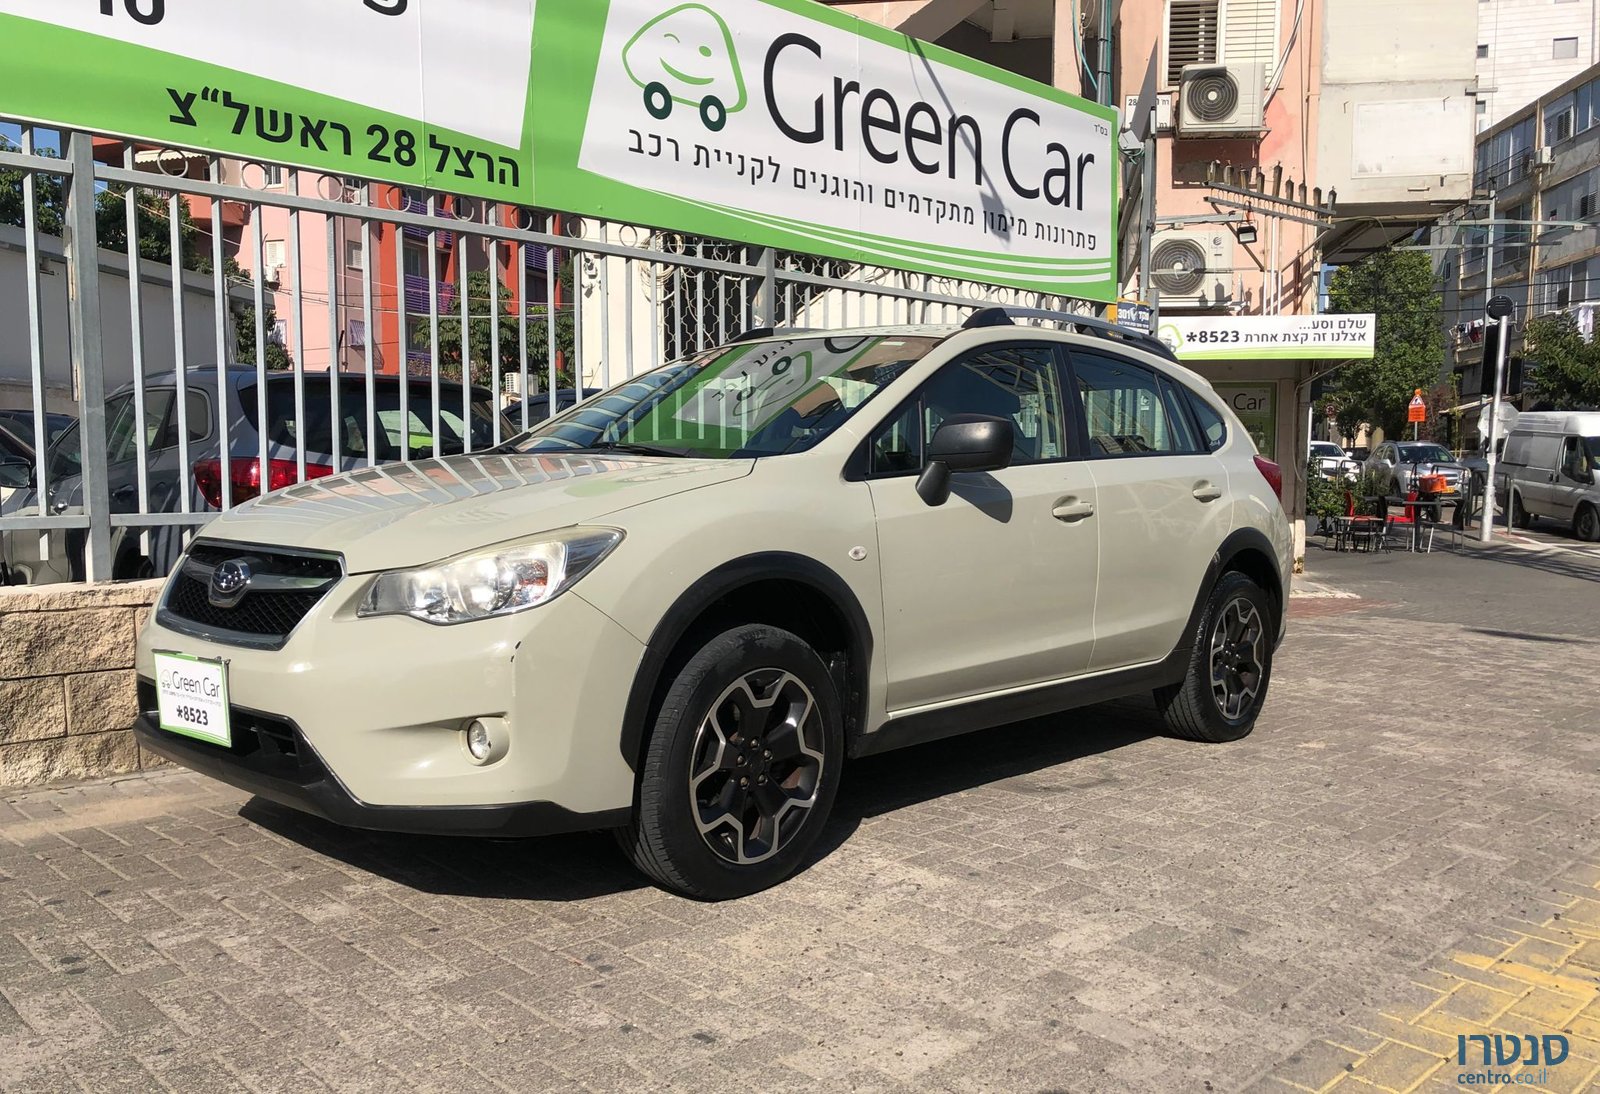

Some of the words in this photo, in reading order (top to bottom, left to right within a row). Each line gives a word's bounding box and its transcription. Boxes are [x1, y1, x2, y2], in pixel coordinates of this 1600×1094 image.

[166, 86, 352, 156] ראשל"צ
[763, 32, 983, 186] Green
[1001, 107, 1095, 211] Car
[366, 123, 417, 167] 28
[628, 129, 681, 162] רכב
[428, 133, 520, 188] הרצל
[693, 144, 782, 187] לקניית
[793, 166, 874, 205] והוגנים
[884, 188, 974, 225] מתקדמים
[983, 210, 1028, 238] מימון
[1034, 222, 1097, 251] פתרונות
[1244, 332, 1279, 343] אחרת
[1313, 332, 1328, 342] זה
[1330, 330, 1366, 342] אצלנו
[1338, 318, 1367, 329] שלם
[1282, 332, 1310, 345] קצת
[1233, 392, 1265, 410] Car
[172, 671, 201, 694] Green
[203, 677, 219, 698] Car
